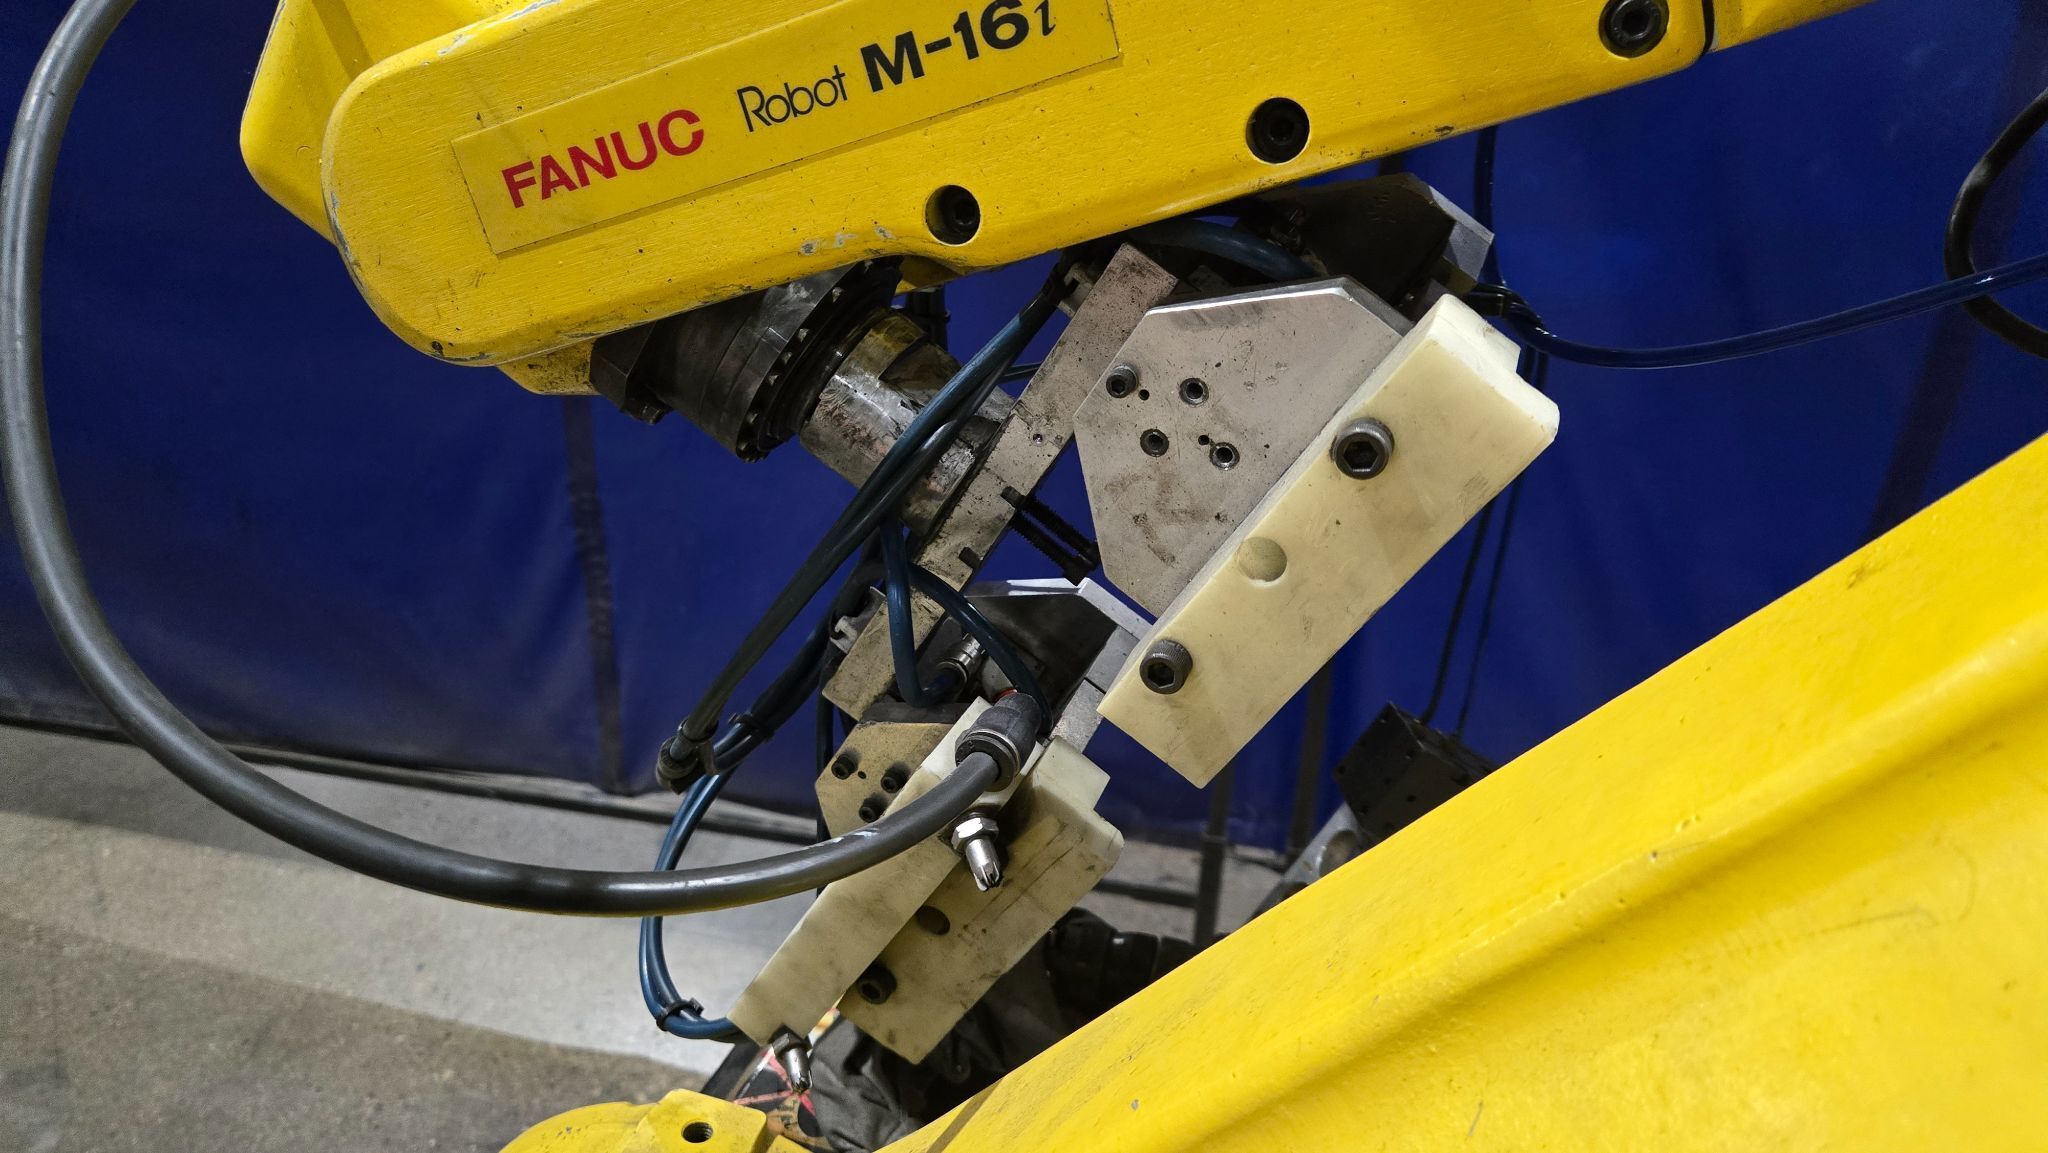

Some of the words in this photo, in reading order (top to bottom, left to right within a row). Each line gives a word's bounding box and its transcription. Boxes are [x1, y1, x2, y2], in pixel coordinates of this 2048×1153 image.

[502, 109, 704, 209] FANUC
[737, 64, 848, 132] Robot
[860, 0, 1056, 93] M-16i
